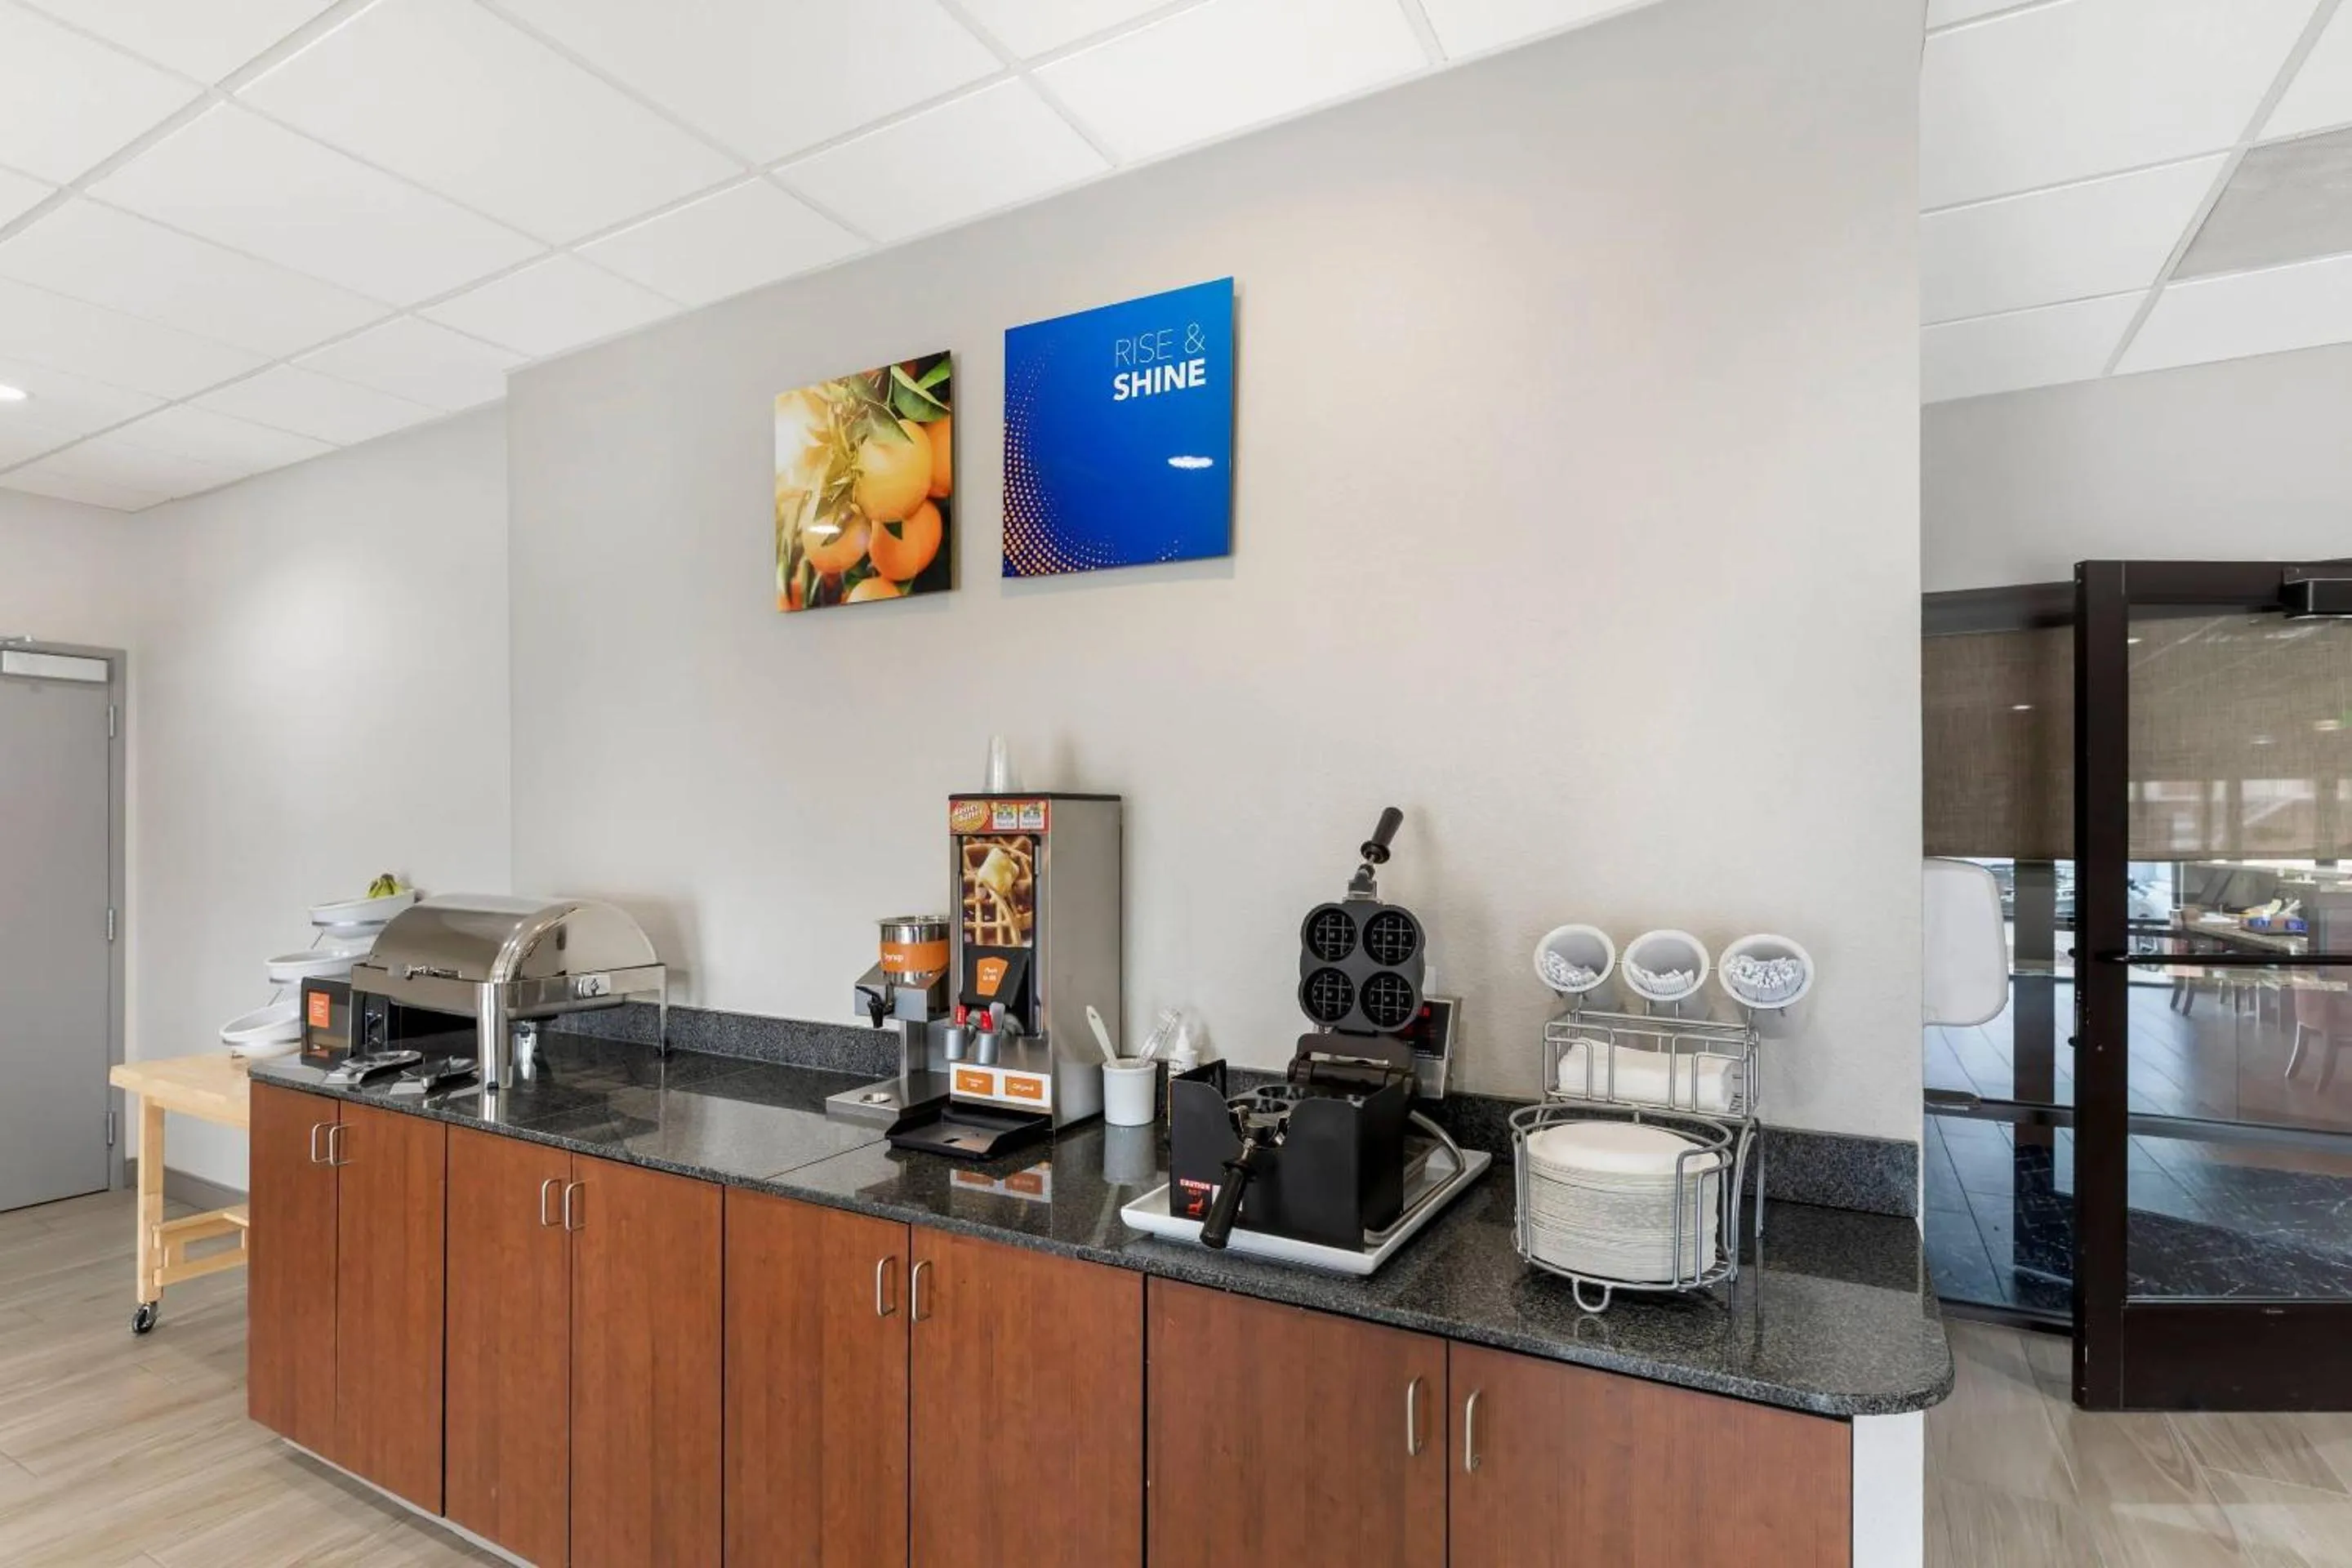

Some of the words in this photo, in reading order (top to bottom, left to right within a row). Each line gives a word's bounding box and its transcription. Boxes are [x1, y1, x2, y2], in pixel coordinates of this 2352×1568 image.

[1116, 329, 1174, 368] RISE
[1185, 322, 1205, 354] &
[1113, 358, 1206, 401] SHINE
